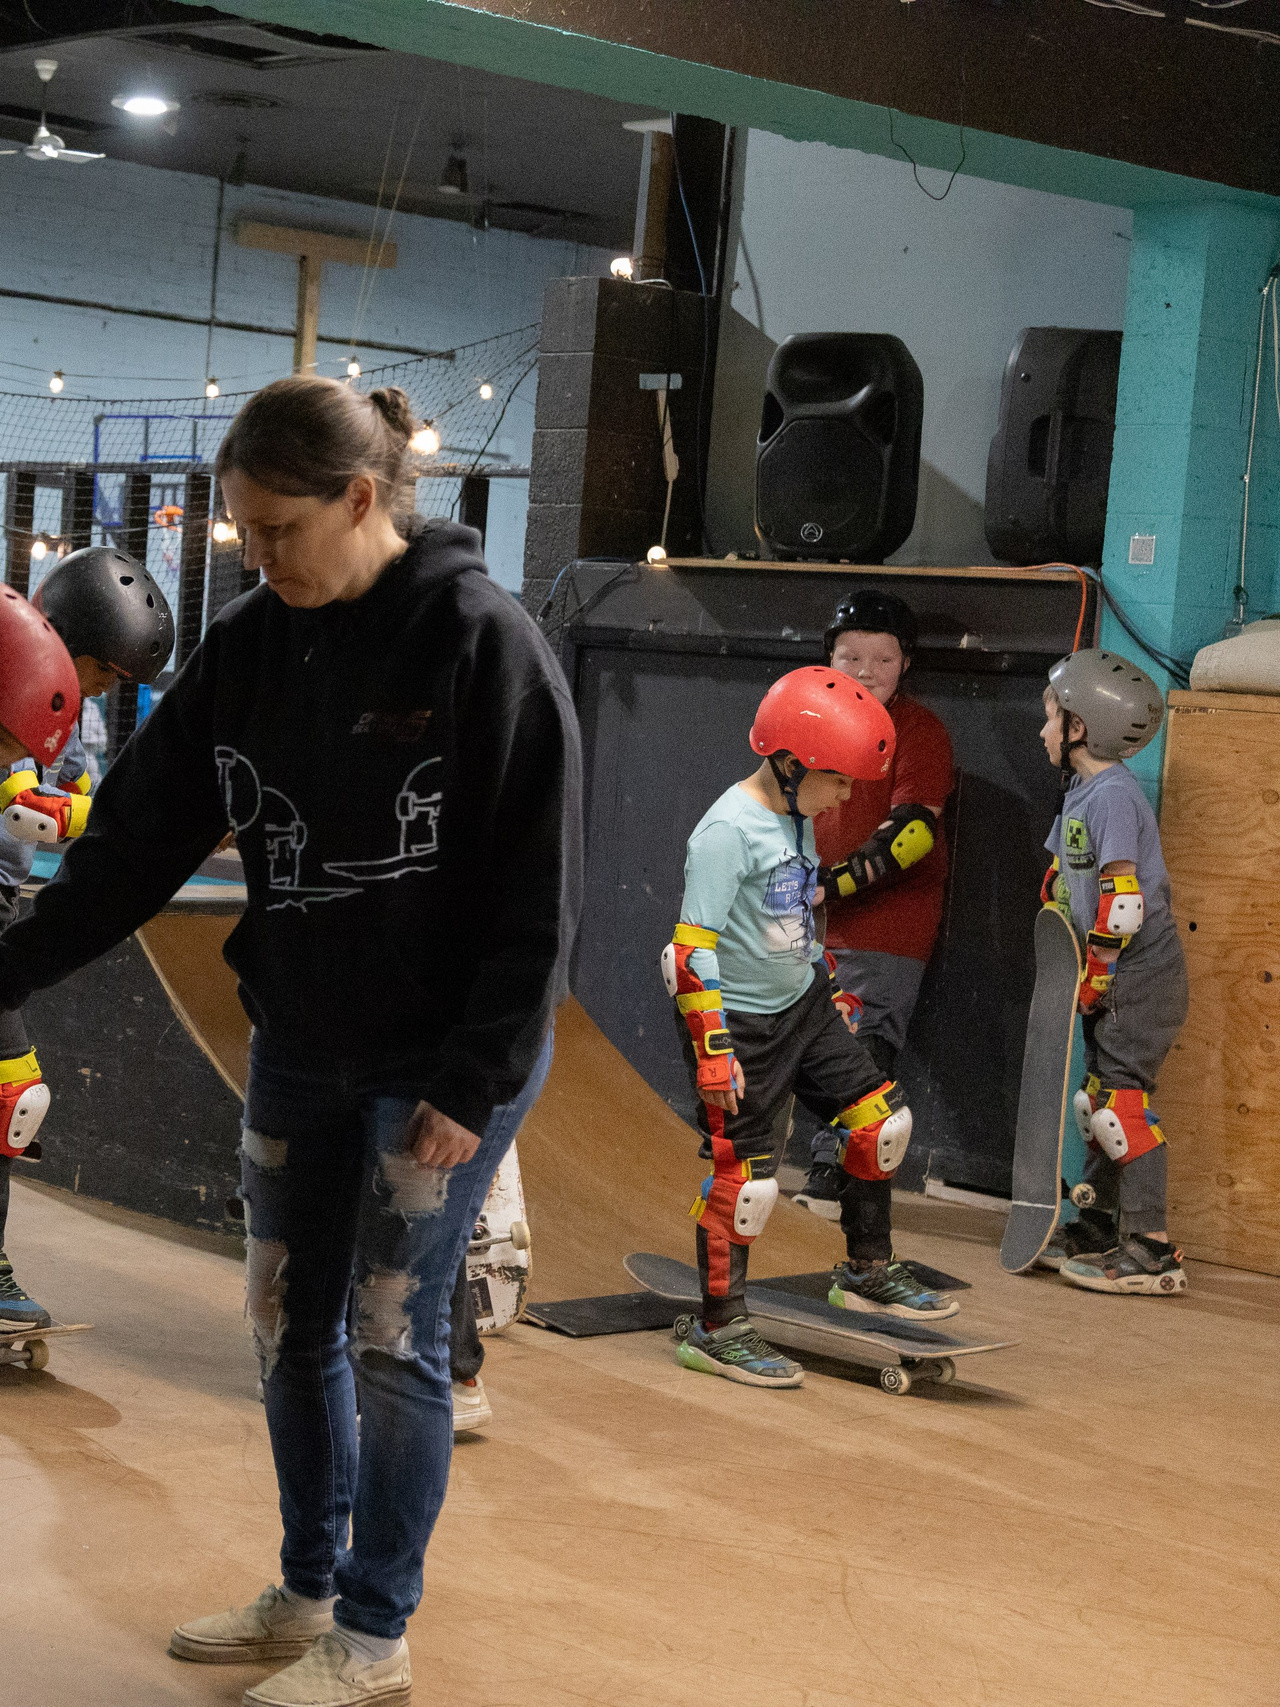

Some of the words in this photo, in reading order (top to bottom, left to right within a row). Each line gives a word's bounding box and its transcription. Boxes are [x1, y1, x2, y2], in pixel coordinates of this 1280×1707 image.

[775, 880, 799, 892] LET'S
[25, 1059, 38, 1073] L
[873, 1103, 890, 1116] L
